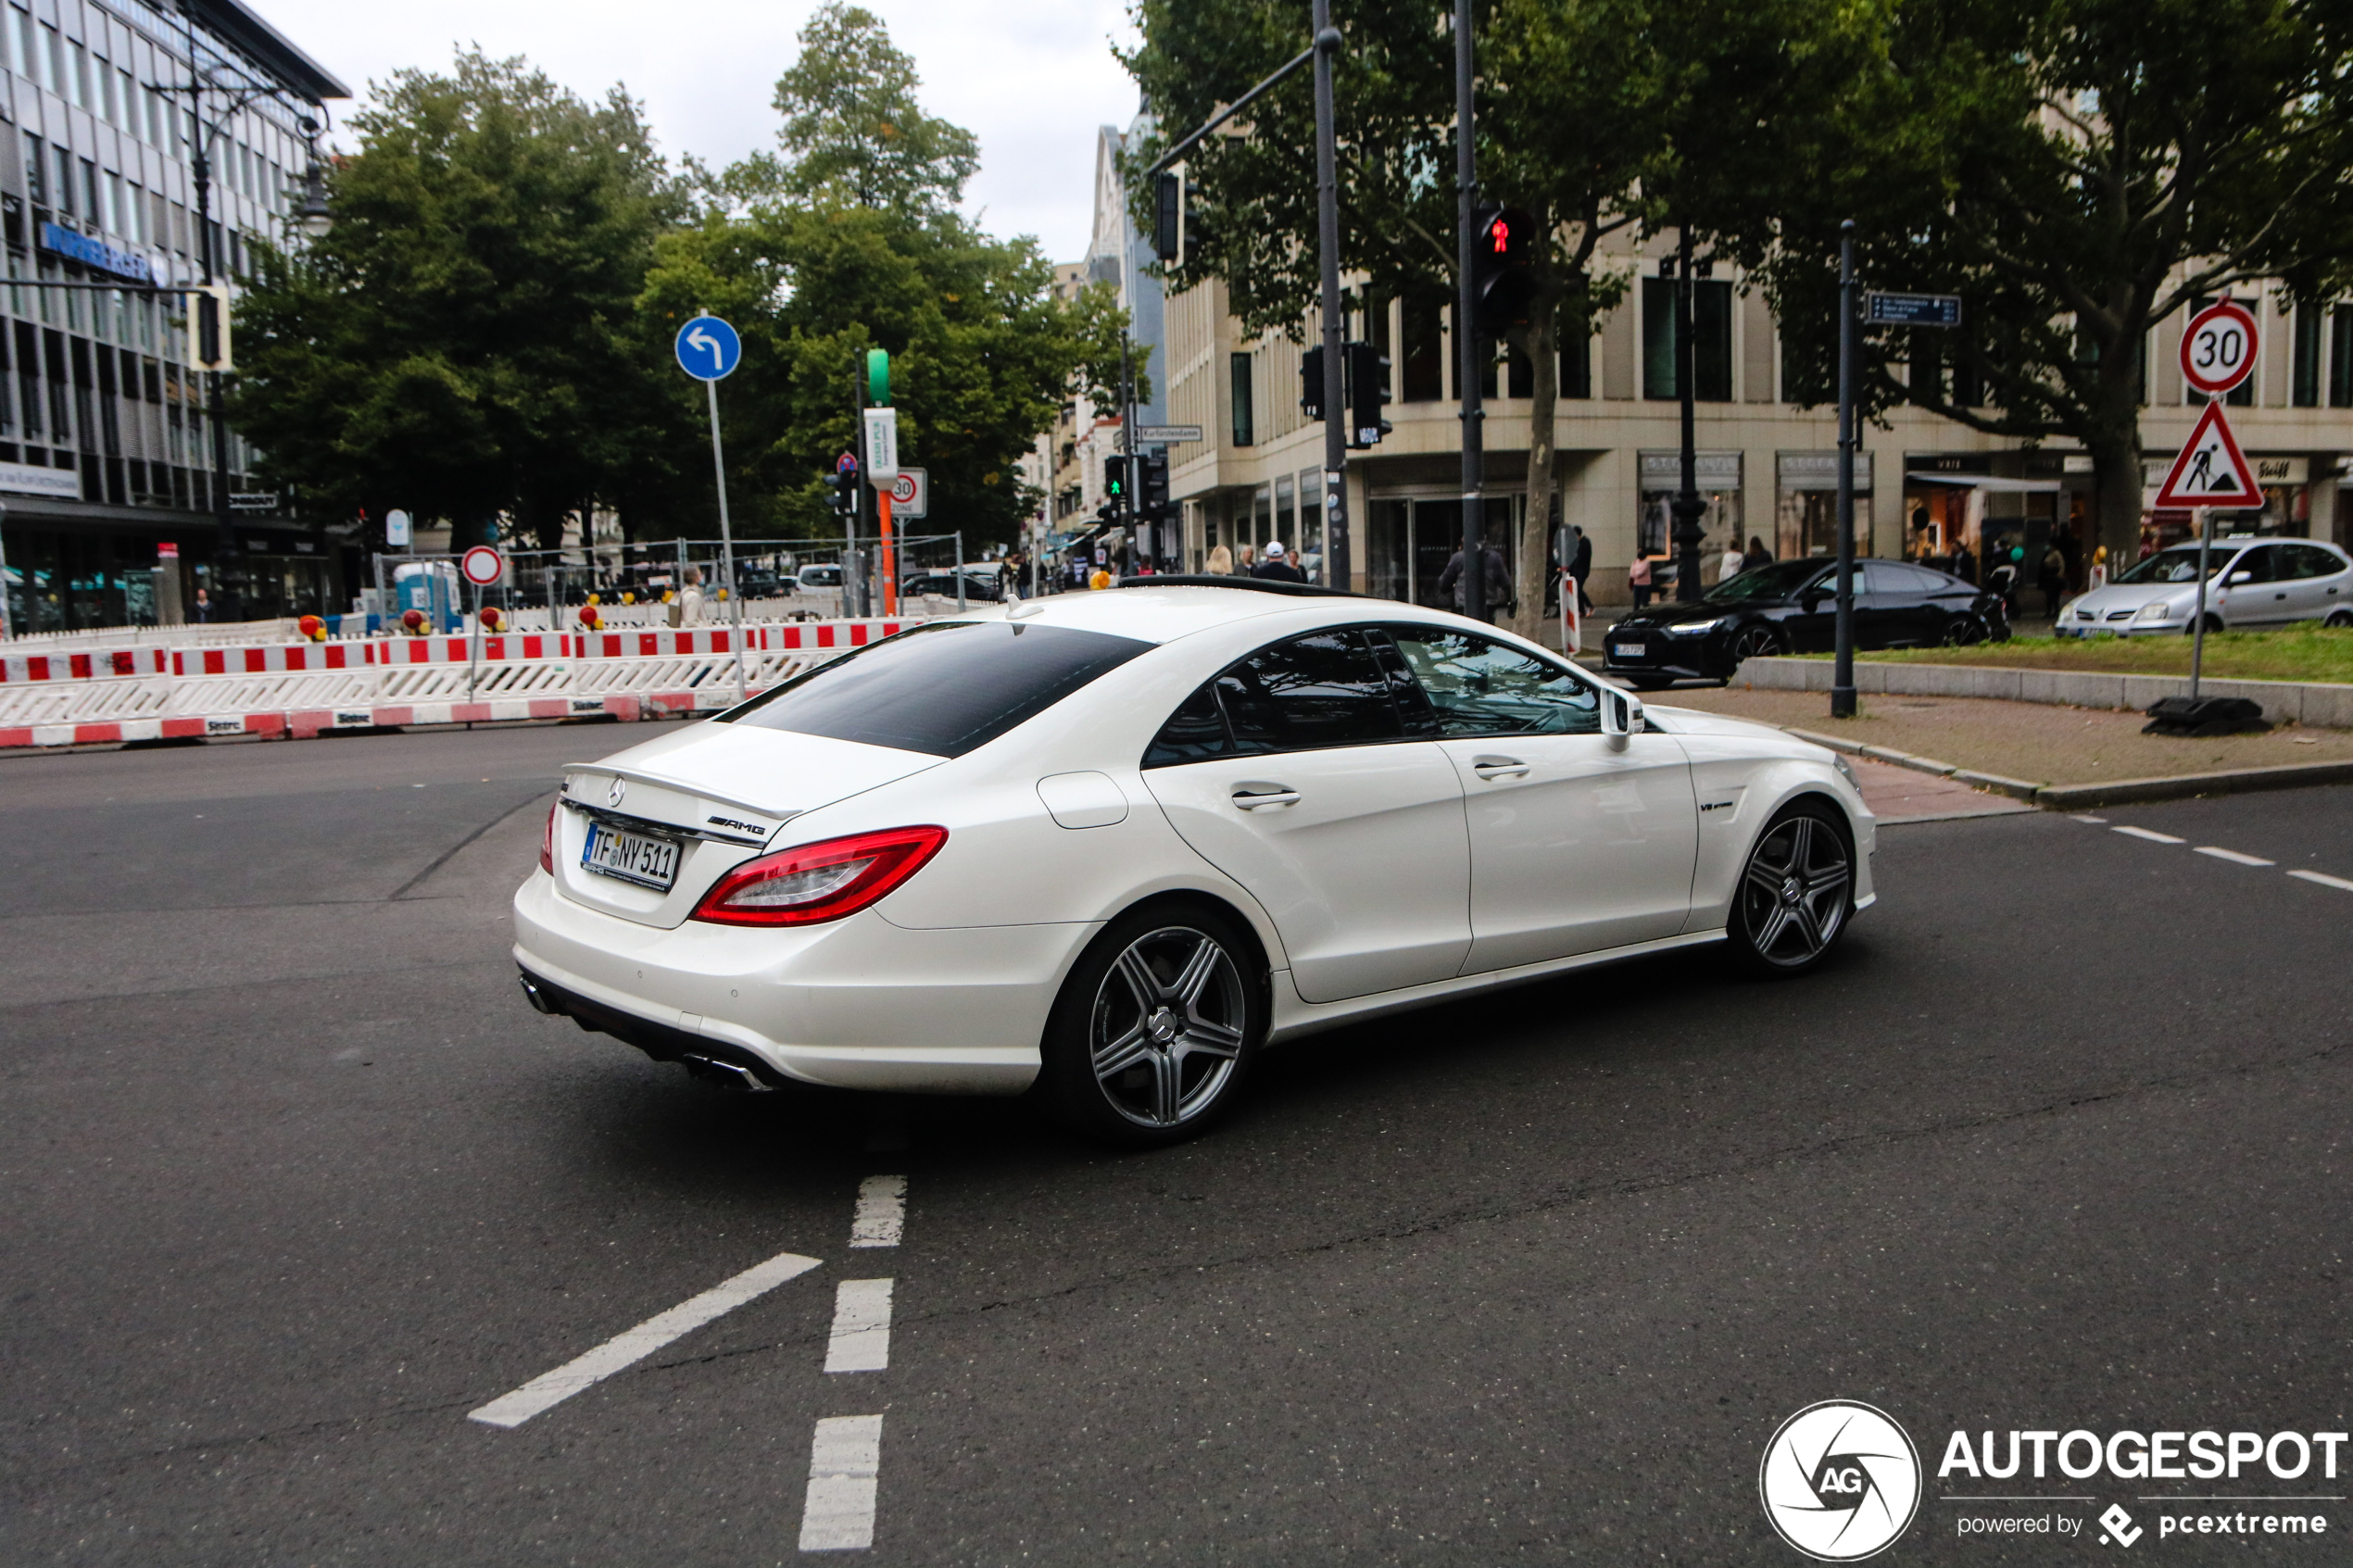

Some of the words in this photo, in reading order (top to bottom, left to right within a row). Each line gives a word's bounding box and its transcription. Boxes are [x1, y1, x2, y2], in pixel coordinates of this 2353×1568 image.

[2196, 330, 2241, 367] 30
[894, 482, 911, 495] 30
[724, 819, 765, 835] AMG
[594, 830, 613, 861] TF
[618, 836, 642, 869] NY
[640, 842, 672, 879] 511
